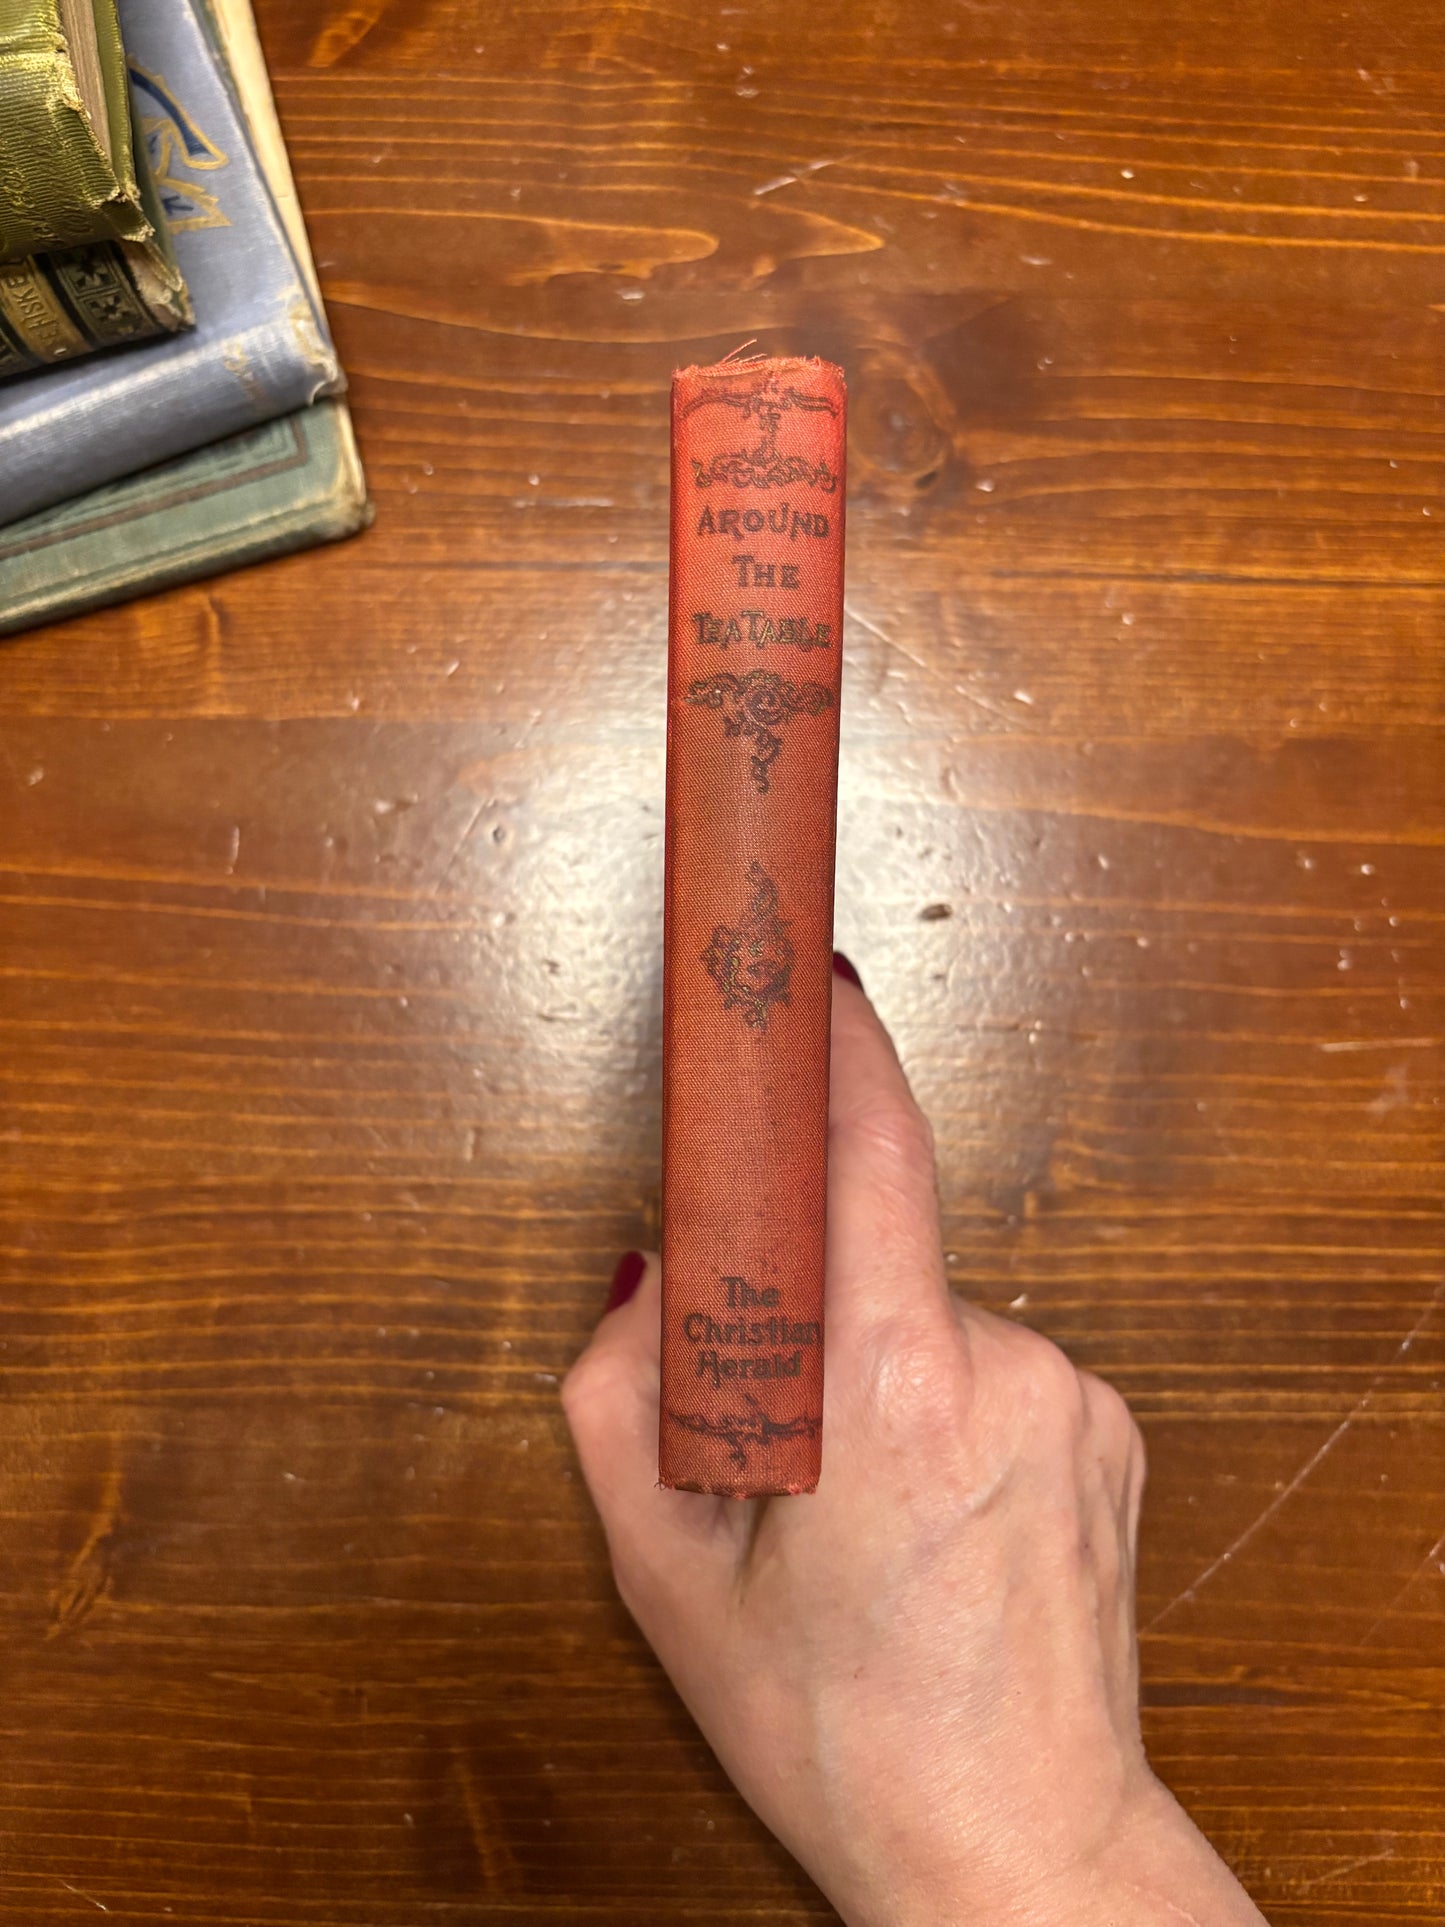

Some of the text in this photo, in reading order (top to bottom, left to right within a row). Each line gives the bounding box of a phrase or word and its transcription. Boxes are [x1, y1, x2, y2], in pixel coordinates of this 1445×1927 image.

[697, 503, 829, 540] AROUND
[731, 554, 800, 589] THE
[720, 1275, 781, 1309] The
[683, 1312, 820, 1346] Christian
[696, 1351, 802, 1390] Herald
